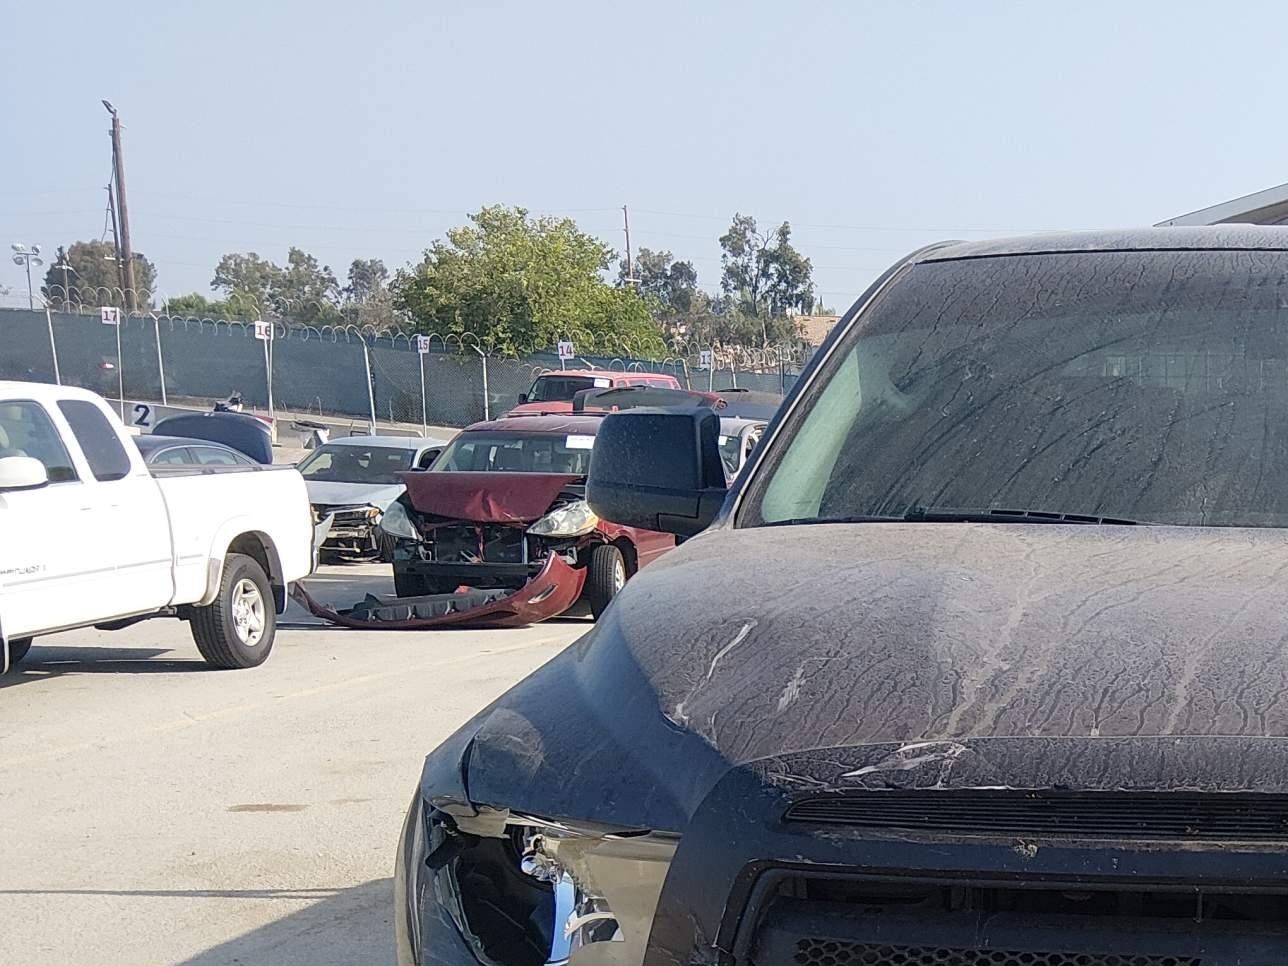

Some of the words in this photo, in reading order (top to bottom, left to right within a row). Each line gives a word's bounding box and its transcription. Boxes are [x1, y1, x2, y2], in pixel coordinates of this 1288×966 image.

[103, 310, 117, 321] 17
[419, 339, 428, 350] 15
[560, 345, 572, 356] 14
[135, 404, 150, 426] 2
